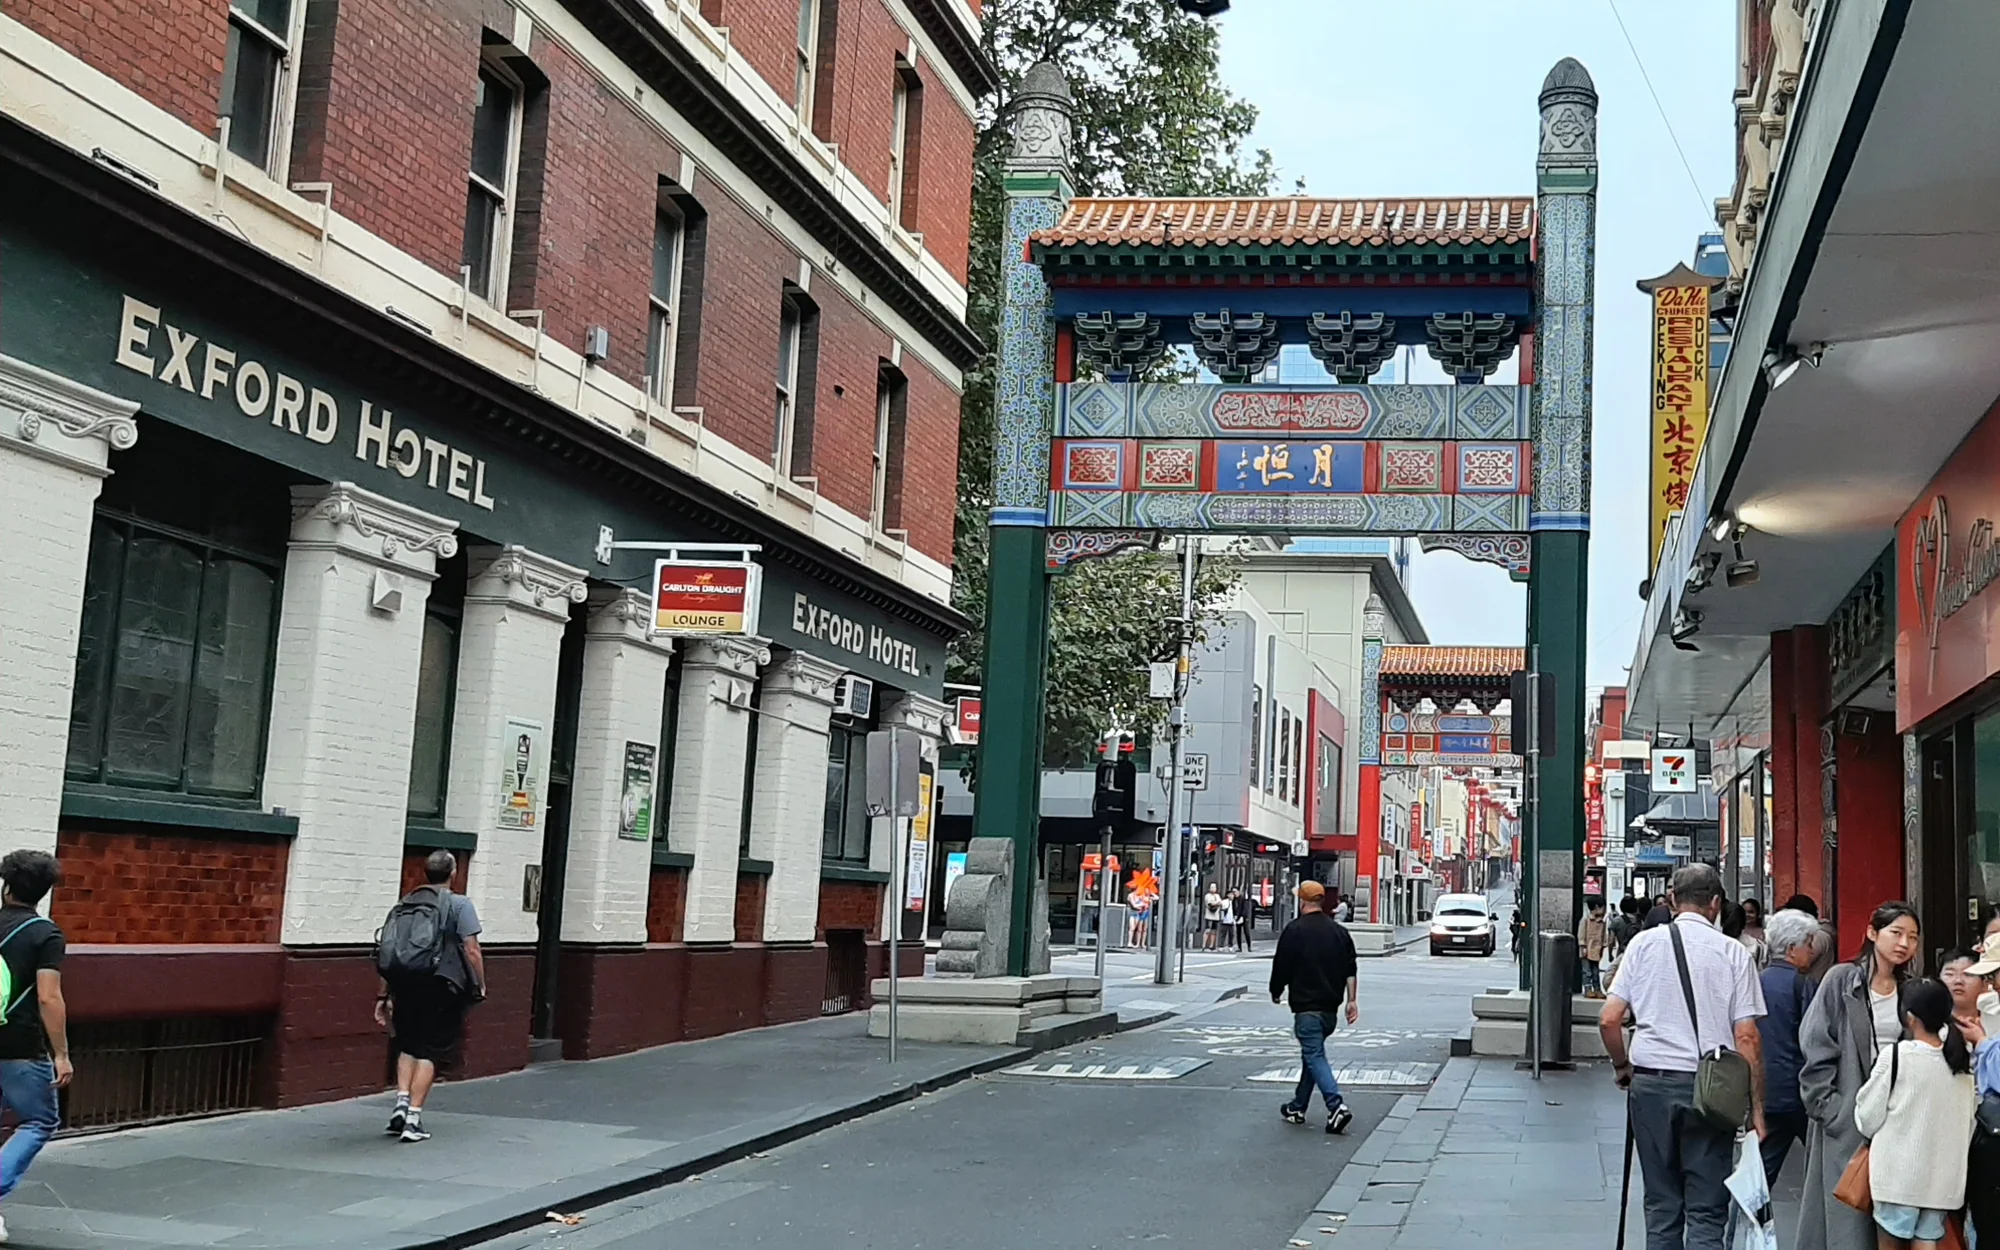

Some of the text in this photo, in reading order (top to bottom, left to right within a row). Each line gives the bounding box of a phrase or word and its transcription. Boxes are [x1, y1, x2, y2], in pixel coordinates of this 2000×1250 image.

[1657, 286, 1683, 307] Da
[1656, 307, 1706, 316] CHINESE
[1694, 316, 1705, 382] DUCK
[1656, 316, 1667, 411] PEKING
[1666, 316, 1693, 412] RESTAURANT
[115, 293, 496, 512] EXFORD HOTEL
[662, 582, 744, 594] CARLTON DRAUGHT
[672, 614, 726, 627] LOUNGE
[792, 592, 920, 677] EXFORD HOTEL
[1184, 756, 1204, 766] ONE
[1184, 767, 1204, 777] WAY
